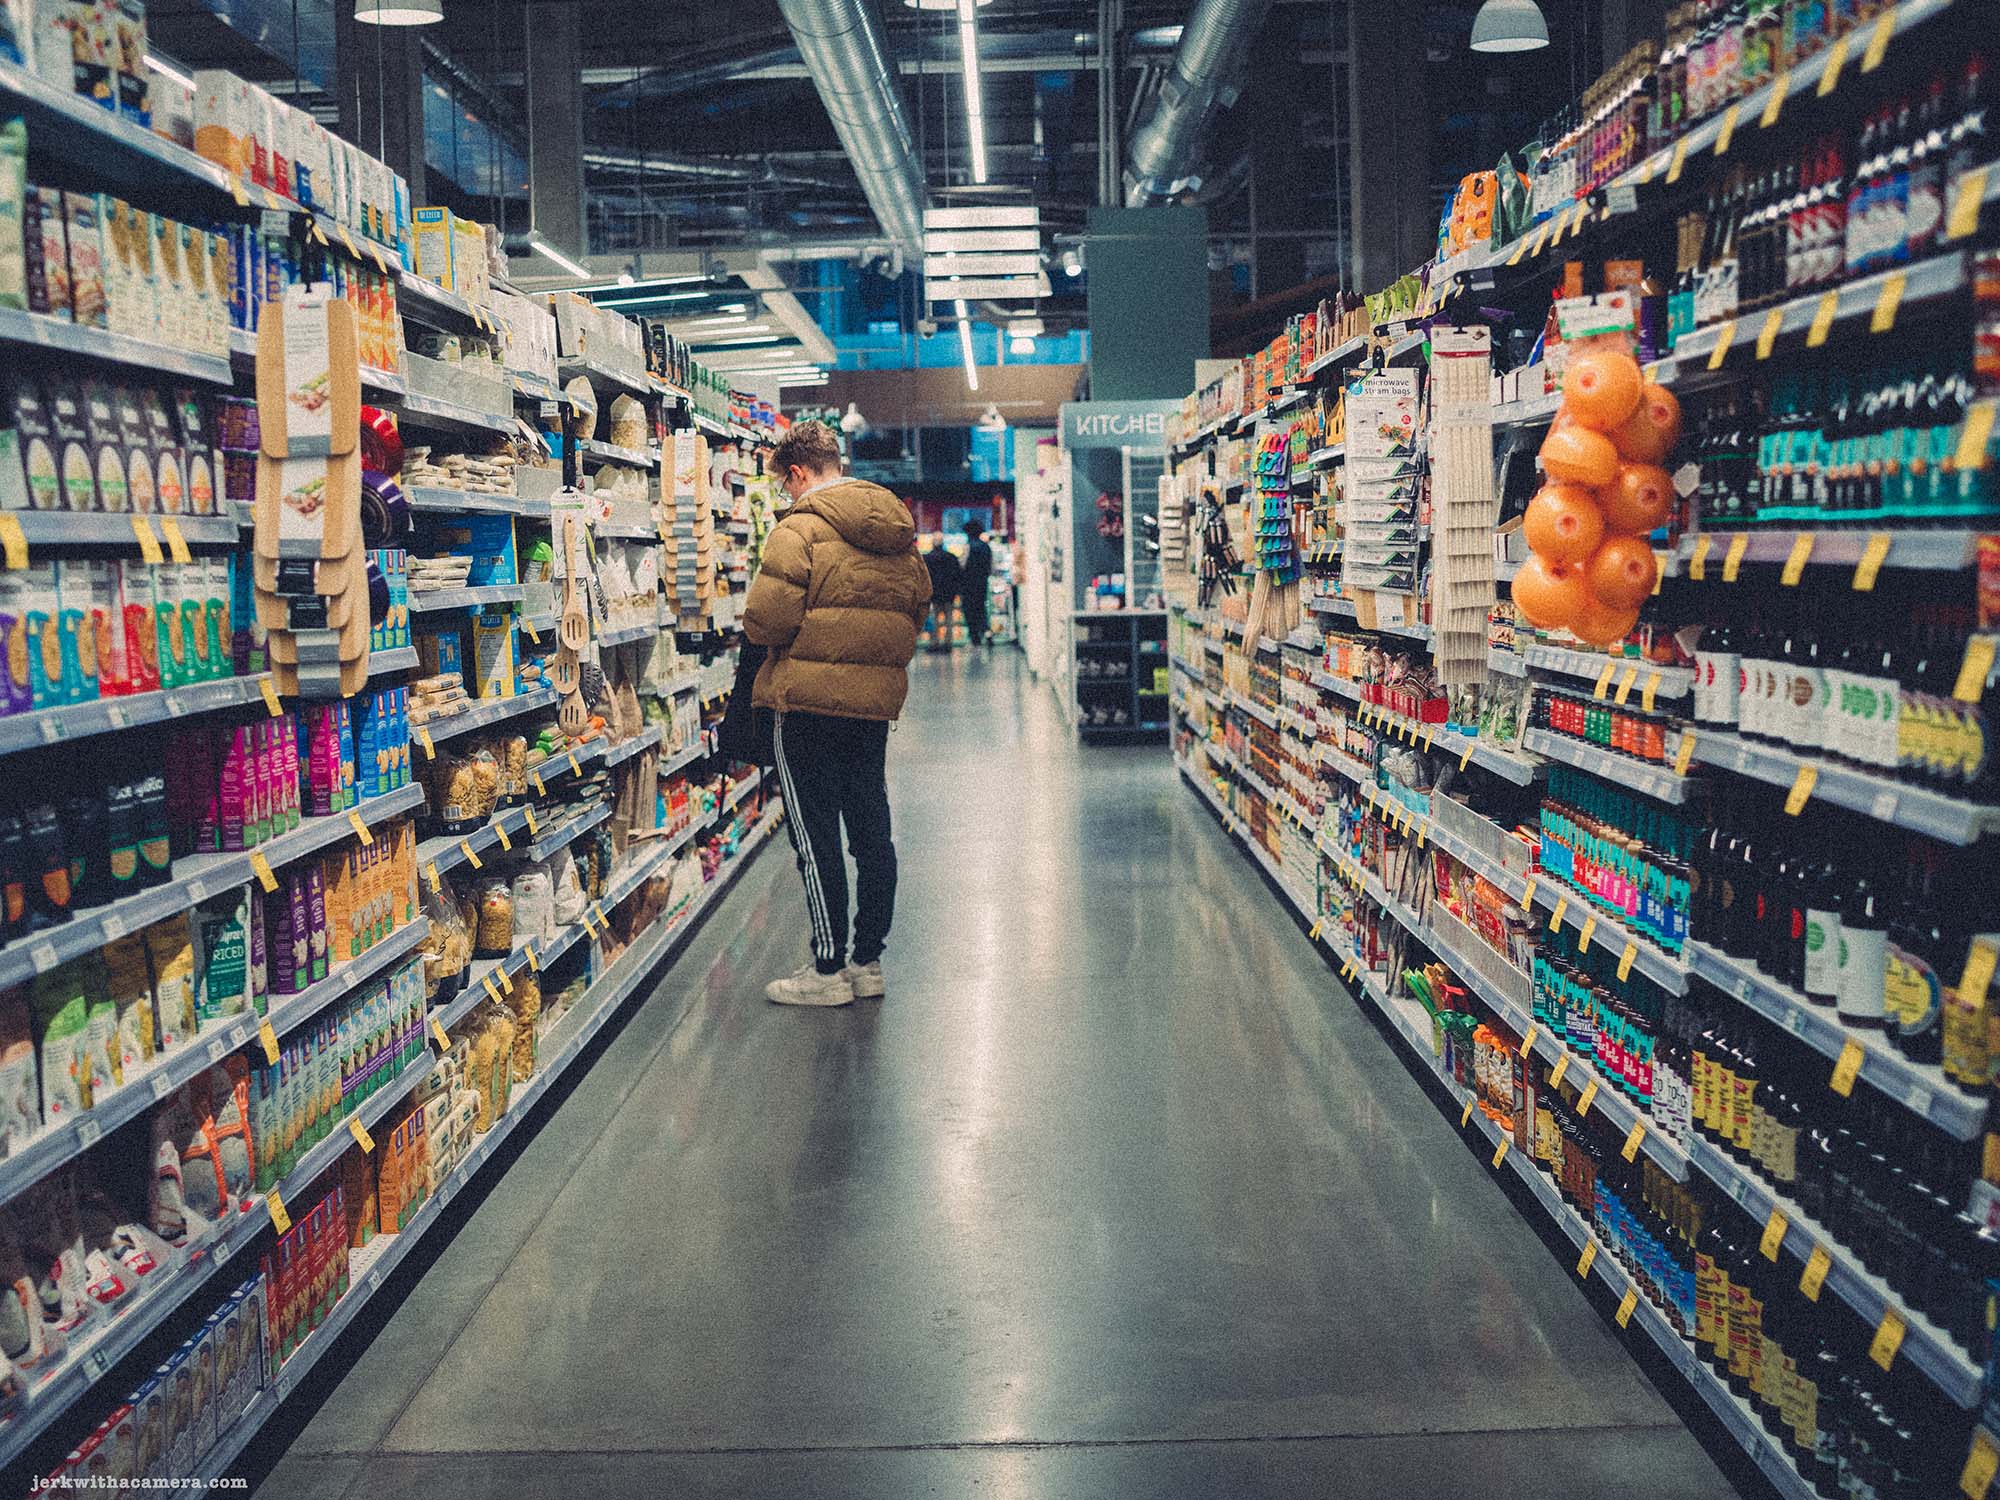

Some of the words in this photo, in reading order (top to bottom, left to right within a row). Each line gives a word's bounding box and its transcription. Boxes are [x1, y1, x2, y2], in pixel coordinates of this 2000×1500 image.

[1365, 379, 1409, 387] microwave
[1391, 387, 1411, 397] bags
[213, 946, 244, 961] RICED
